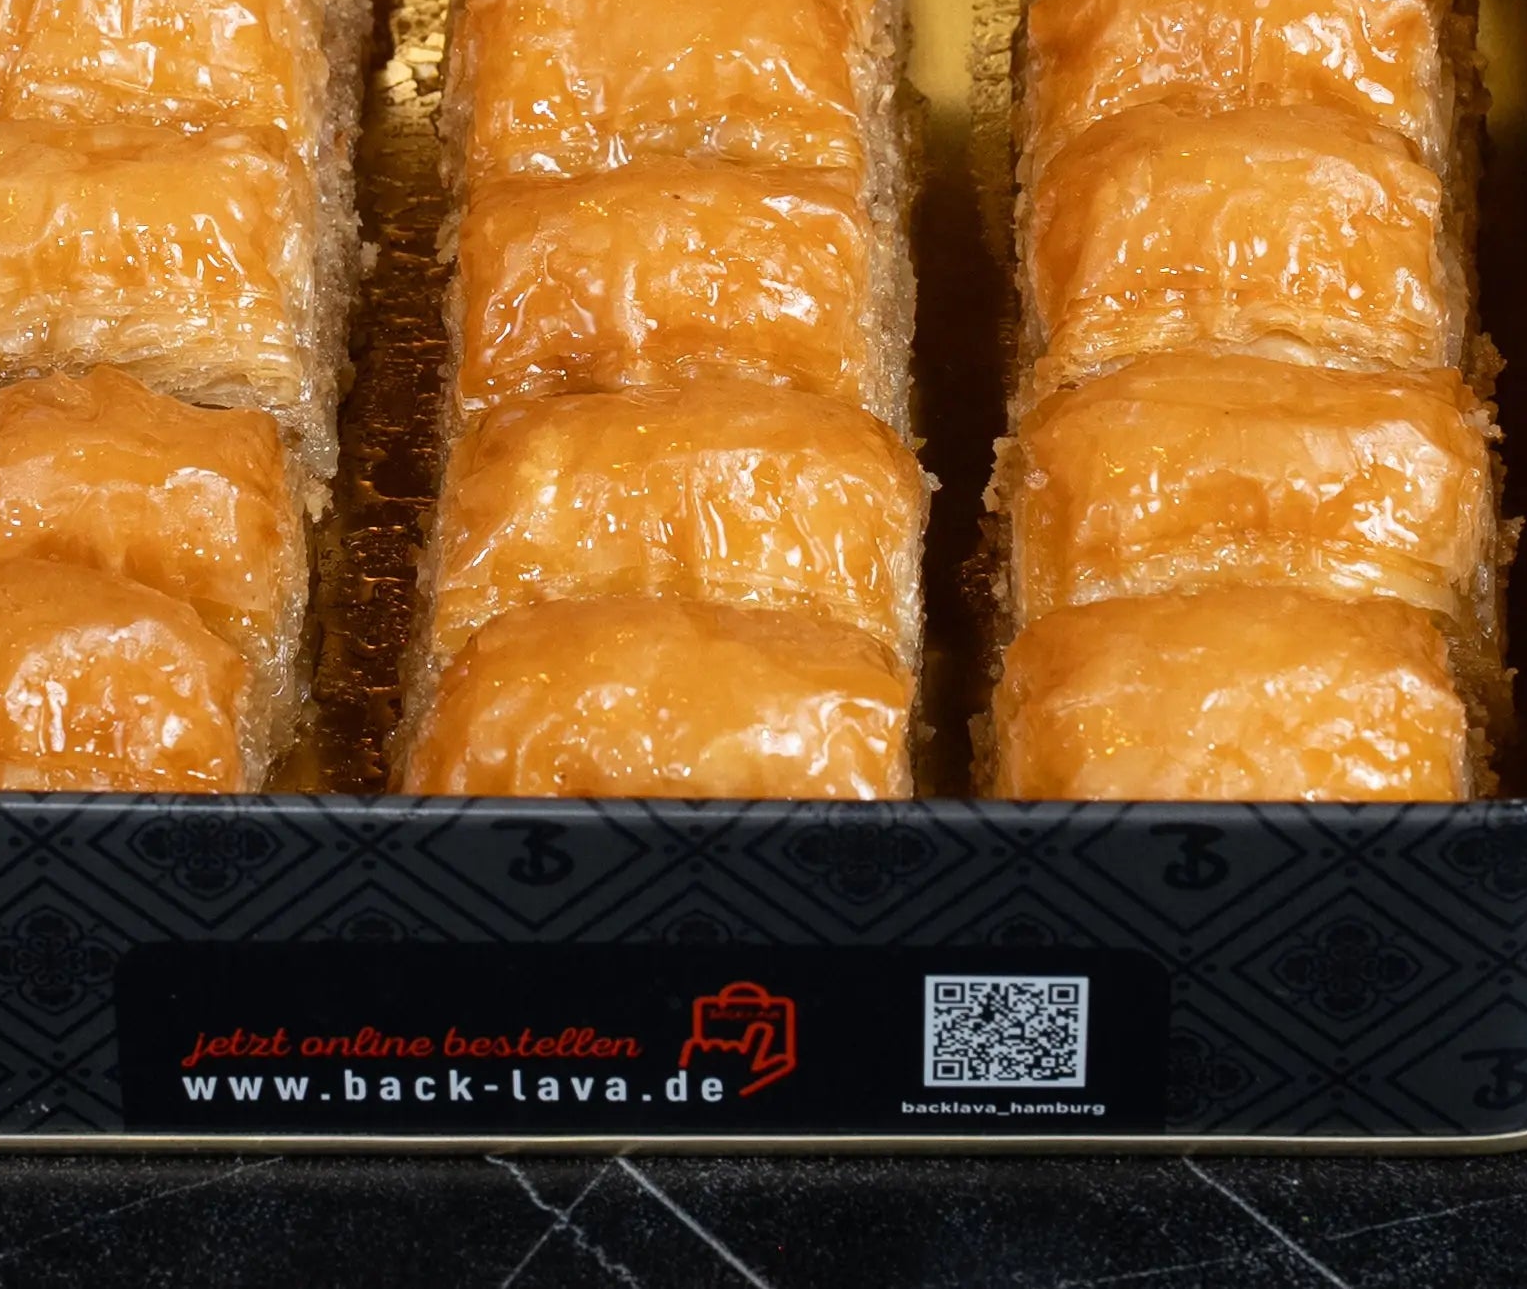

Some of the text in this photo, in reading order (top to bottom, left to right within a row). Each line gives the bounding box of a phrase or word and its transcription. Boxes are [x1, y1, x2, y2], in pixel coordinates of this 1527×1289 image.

[181, 1025, 643, 1068] jetzt online bestellen
[182, 1068, 724, 1102] www.back-lava.de
[901, 1101, 1106, 1117] backlava_hamburg
